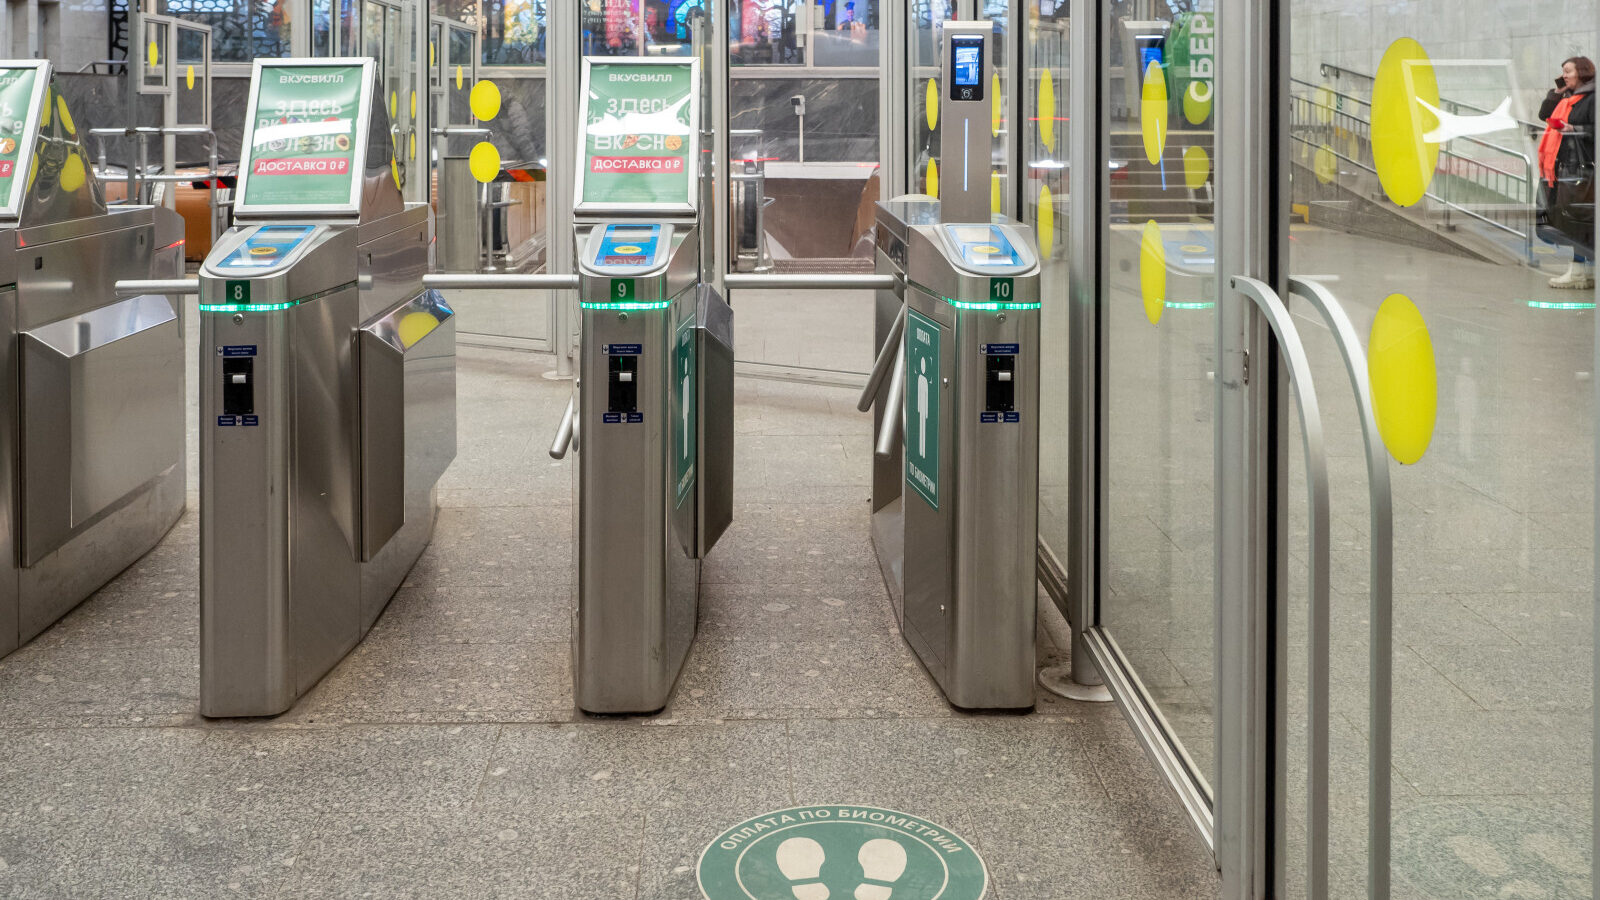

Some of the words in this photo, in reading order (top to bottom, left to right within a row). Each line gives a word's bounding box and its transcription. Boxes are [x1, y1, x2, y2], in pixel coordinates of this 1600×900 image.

[1189, 13, 1214, 103] СБЕР
[279, 74, 344, 84] ВКУСВИЛЛ
[608, 73, 672, 82] ВКУСВИЛЛ
[234, 284, 243, 300] 8
[617, 282, 627, 297] 9
[993, 282, 1010, 297] 10
[720, 814, 796, 850] ОПЛАТА
[798, 809, 831, 819] ПО
[838, 809, 963, 853] БИОМЕТРИИ
